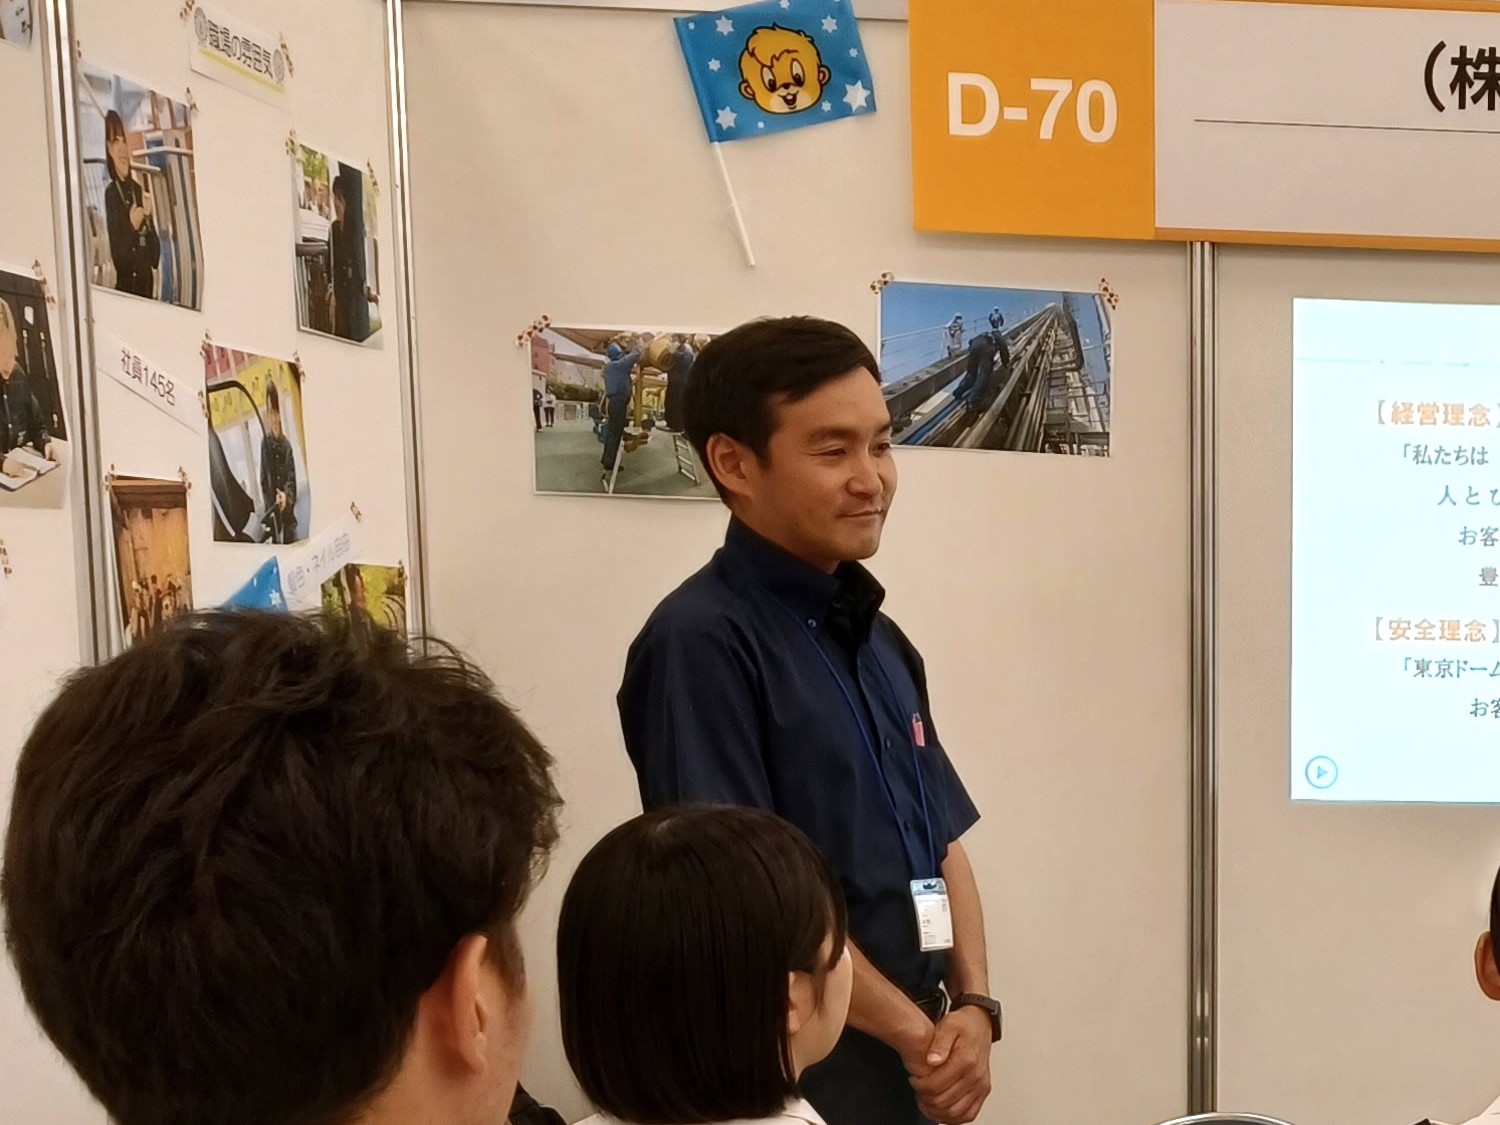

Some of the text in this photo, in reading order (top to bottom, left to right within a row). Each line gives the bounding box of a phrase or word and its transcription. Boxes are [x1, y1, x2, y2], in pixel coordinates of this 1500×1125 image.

[943, 72, 1119, 144] D-70
[1402, 443, 1490, 466] 「私たちは
[1374, 615, 1500, 644] 【安全理念】
